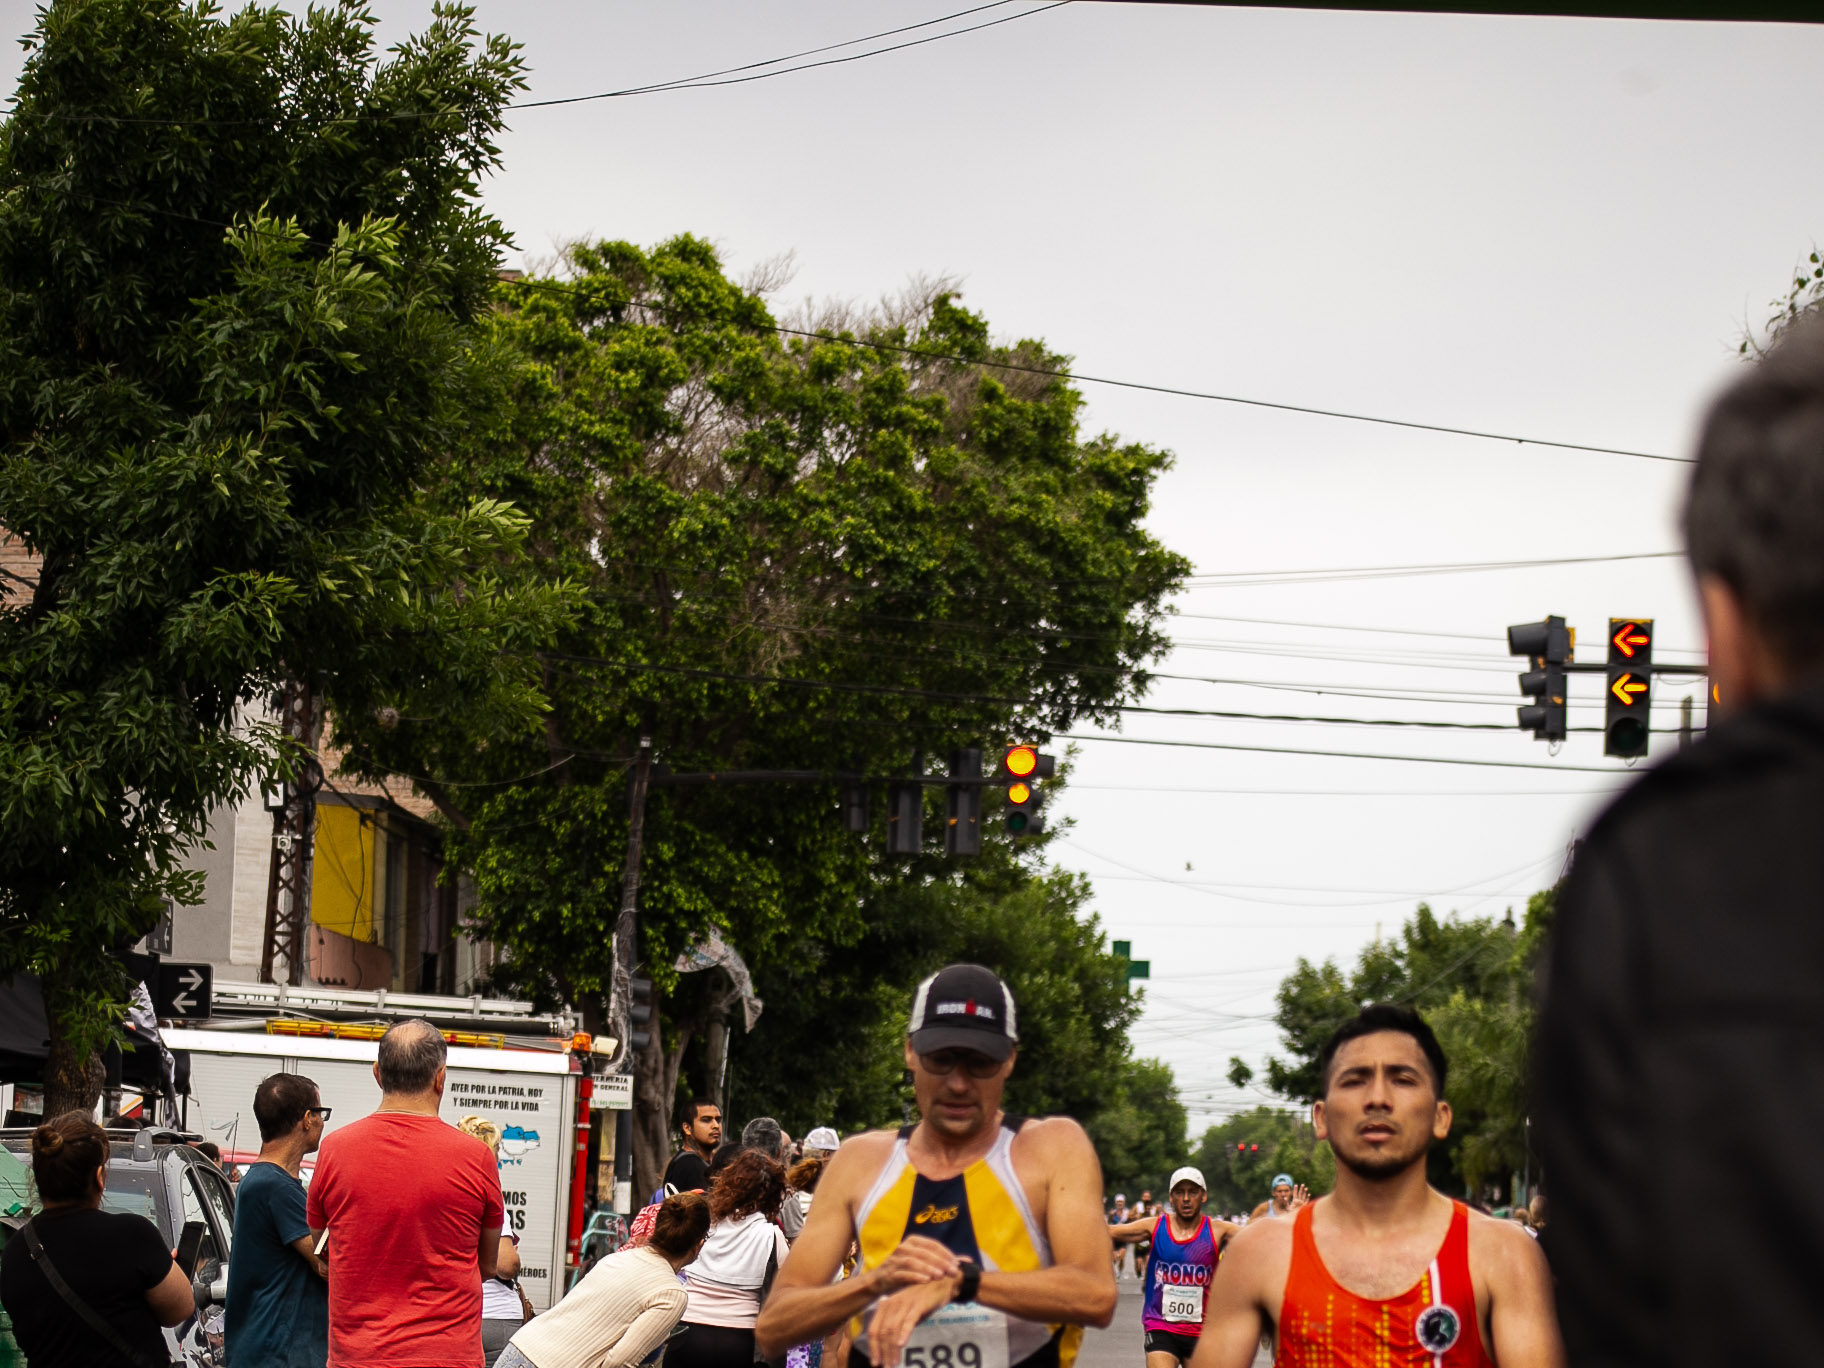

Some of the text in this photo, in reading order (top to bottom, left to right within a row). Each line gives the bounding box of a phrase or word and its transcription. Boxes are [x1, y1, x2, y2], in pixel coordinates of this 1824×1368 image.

[450, 1083, 544, 1098] AYER POR LA PATRIA, HOY
[453, 1097, 539, 1112] Y SIEMPRE POR LA VIDA
[1169, 1301, 1194, 1315] 500
